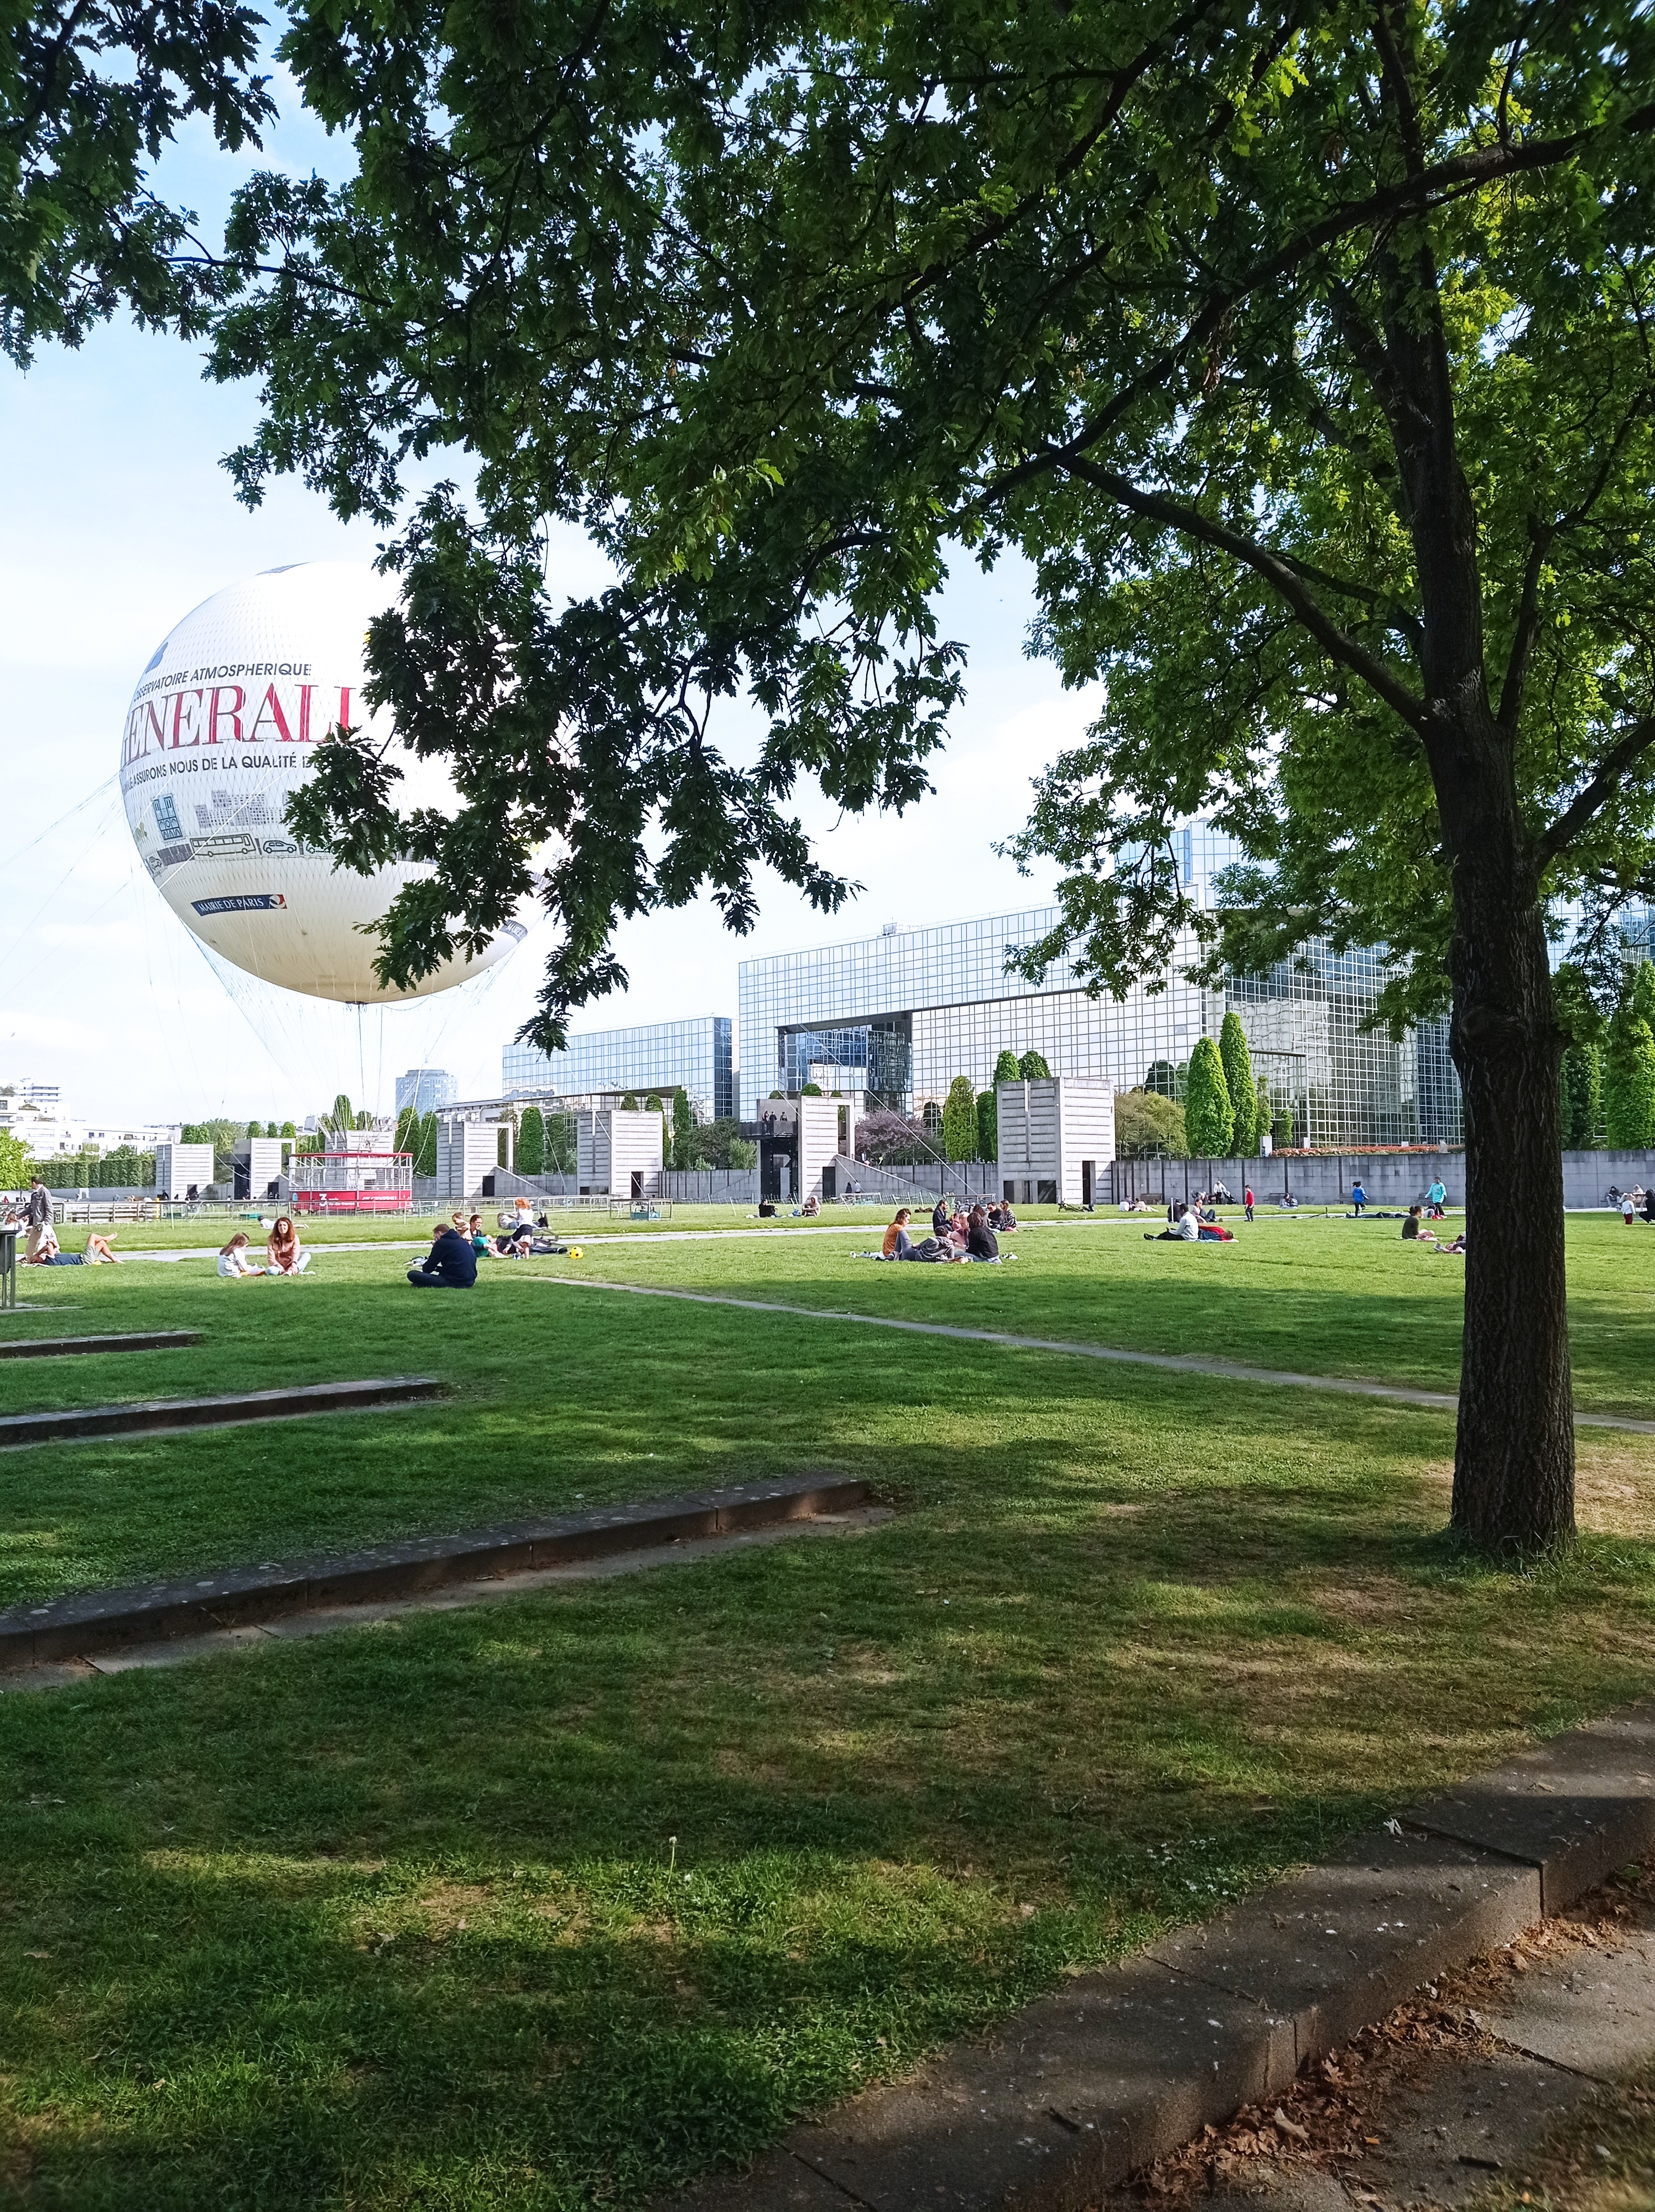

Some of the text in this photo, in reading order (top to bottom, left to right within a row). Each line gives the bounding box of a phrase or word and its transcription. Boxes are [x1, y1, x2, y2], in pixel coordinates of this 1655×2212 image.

[190, 663, 311, 682] ATMOSPHERIQUE
[133, 764, 166, 787] ASSURONS
[169, 759, 199, 775] NOUS
[202, 758, 217, 771] DE
[222, 757, 238, 769] LA
[242, 752, 297, 769] QUALITÉ
[197, 898, 264, 912] MAIRIE DE PARIS
[319, 1193, 327, 1206] 3
